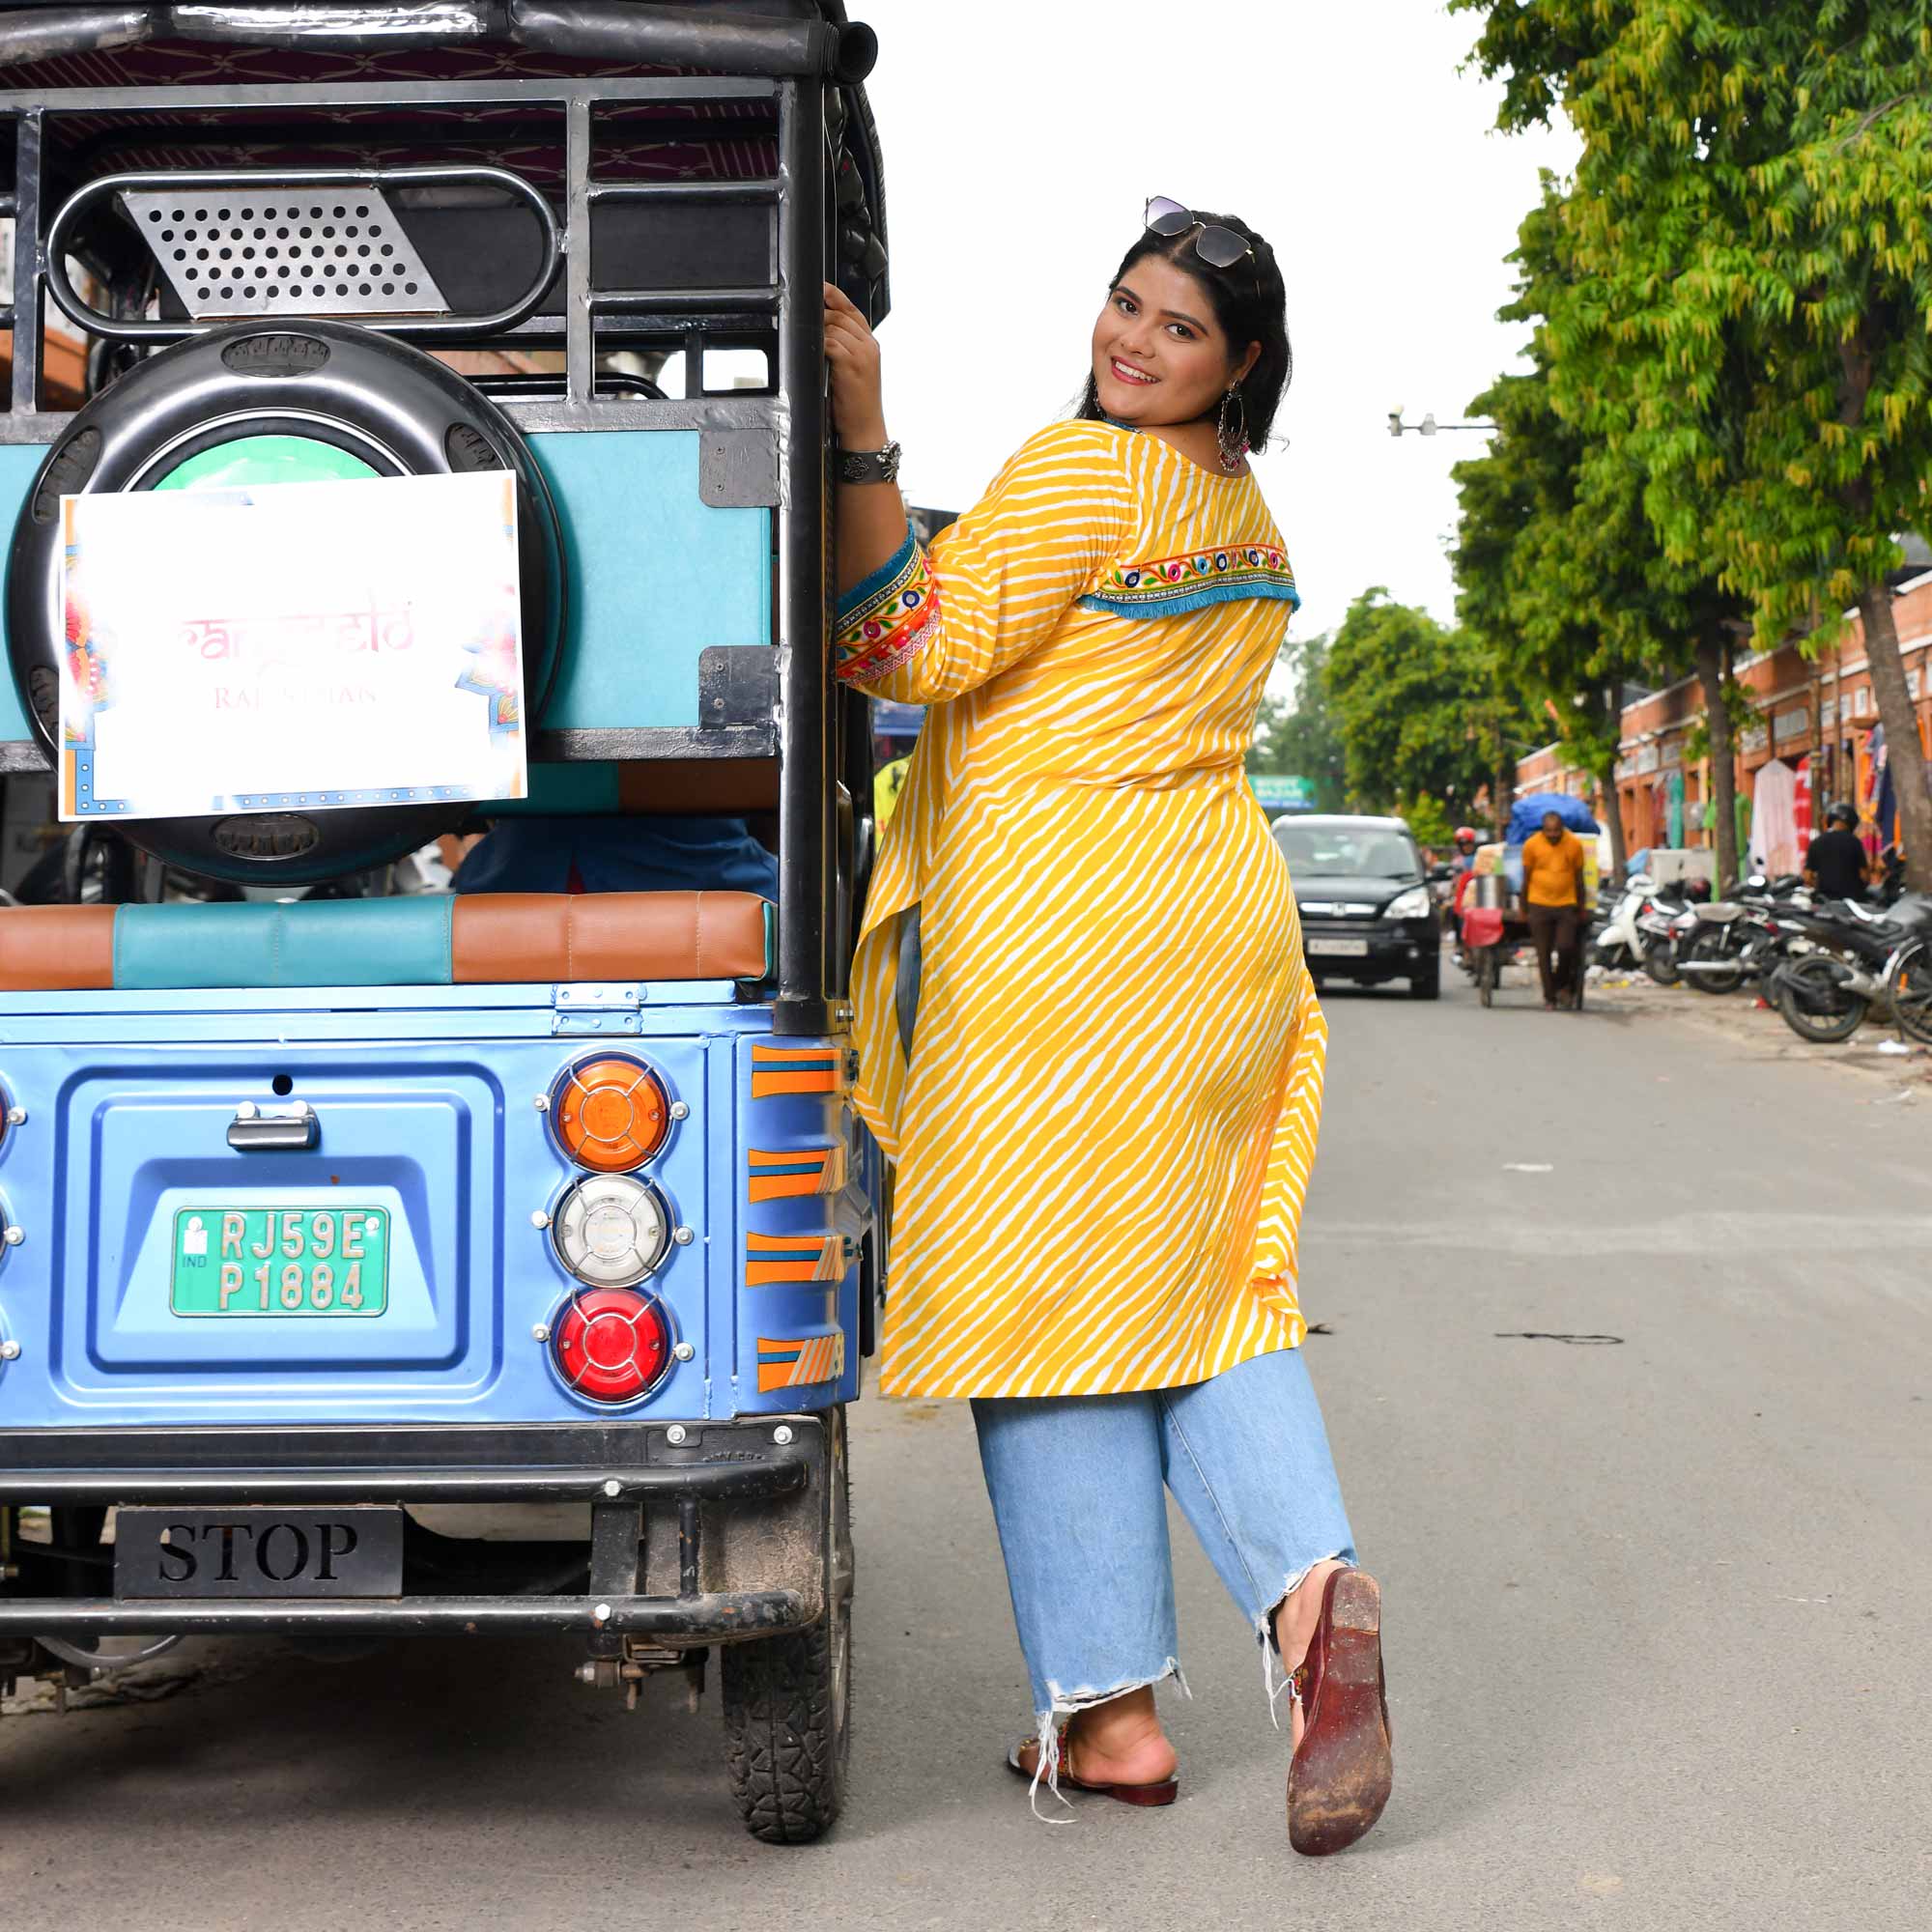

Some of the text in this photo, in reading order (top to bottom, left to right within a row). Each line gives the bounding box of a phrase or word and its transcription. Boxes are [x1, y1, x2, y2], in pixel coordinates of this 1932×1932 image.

[221, 1212, 366, 1260] RJ59E
[182, 1256, 208, 1268] IND
[218, 1262, 364, 1310] P1884
[157, 1524, 358, 1581] STOP
